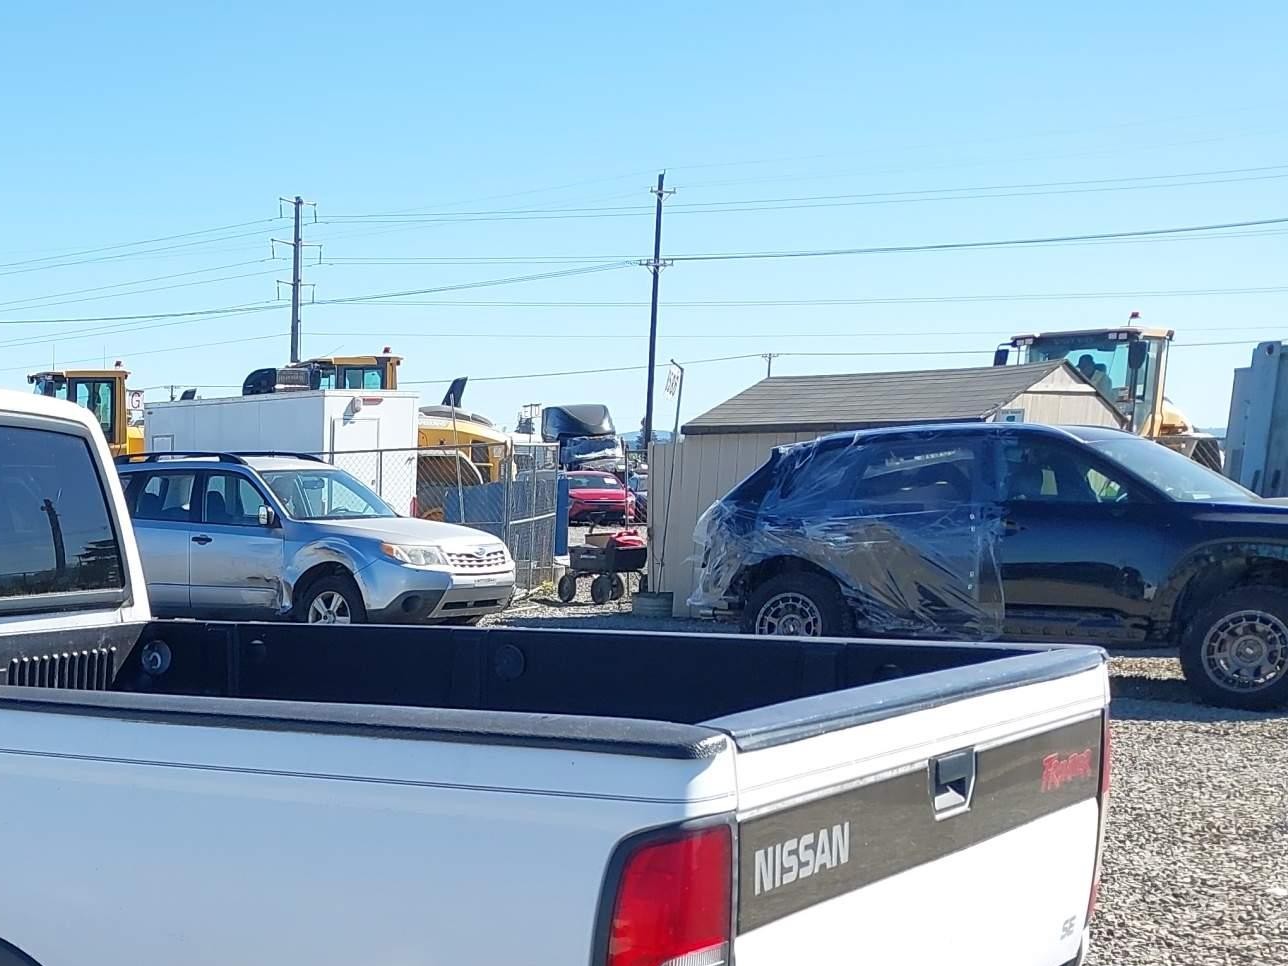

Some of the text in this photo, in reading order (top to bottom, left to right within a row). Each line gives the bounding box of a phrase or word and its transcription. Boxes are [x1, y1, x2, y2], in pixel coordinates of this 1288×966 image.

[130, 391, 141, 409] G
[753, 822, 850, 896] NISSAN
[1060, 915, 1077, 940] SE
